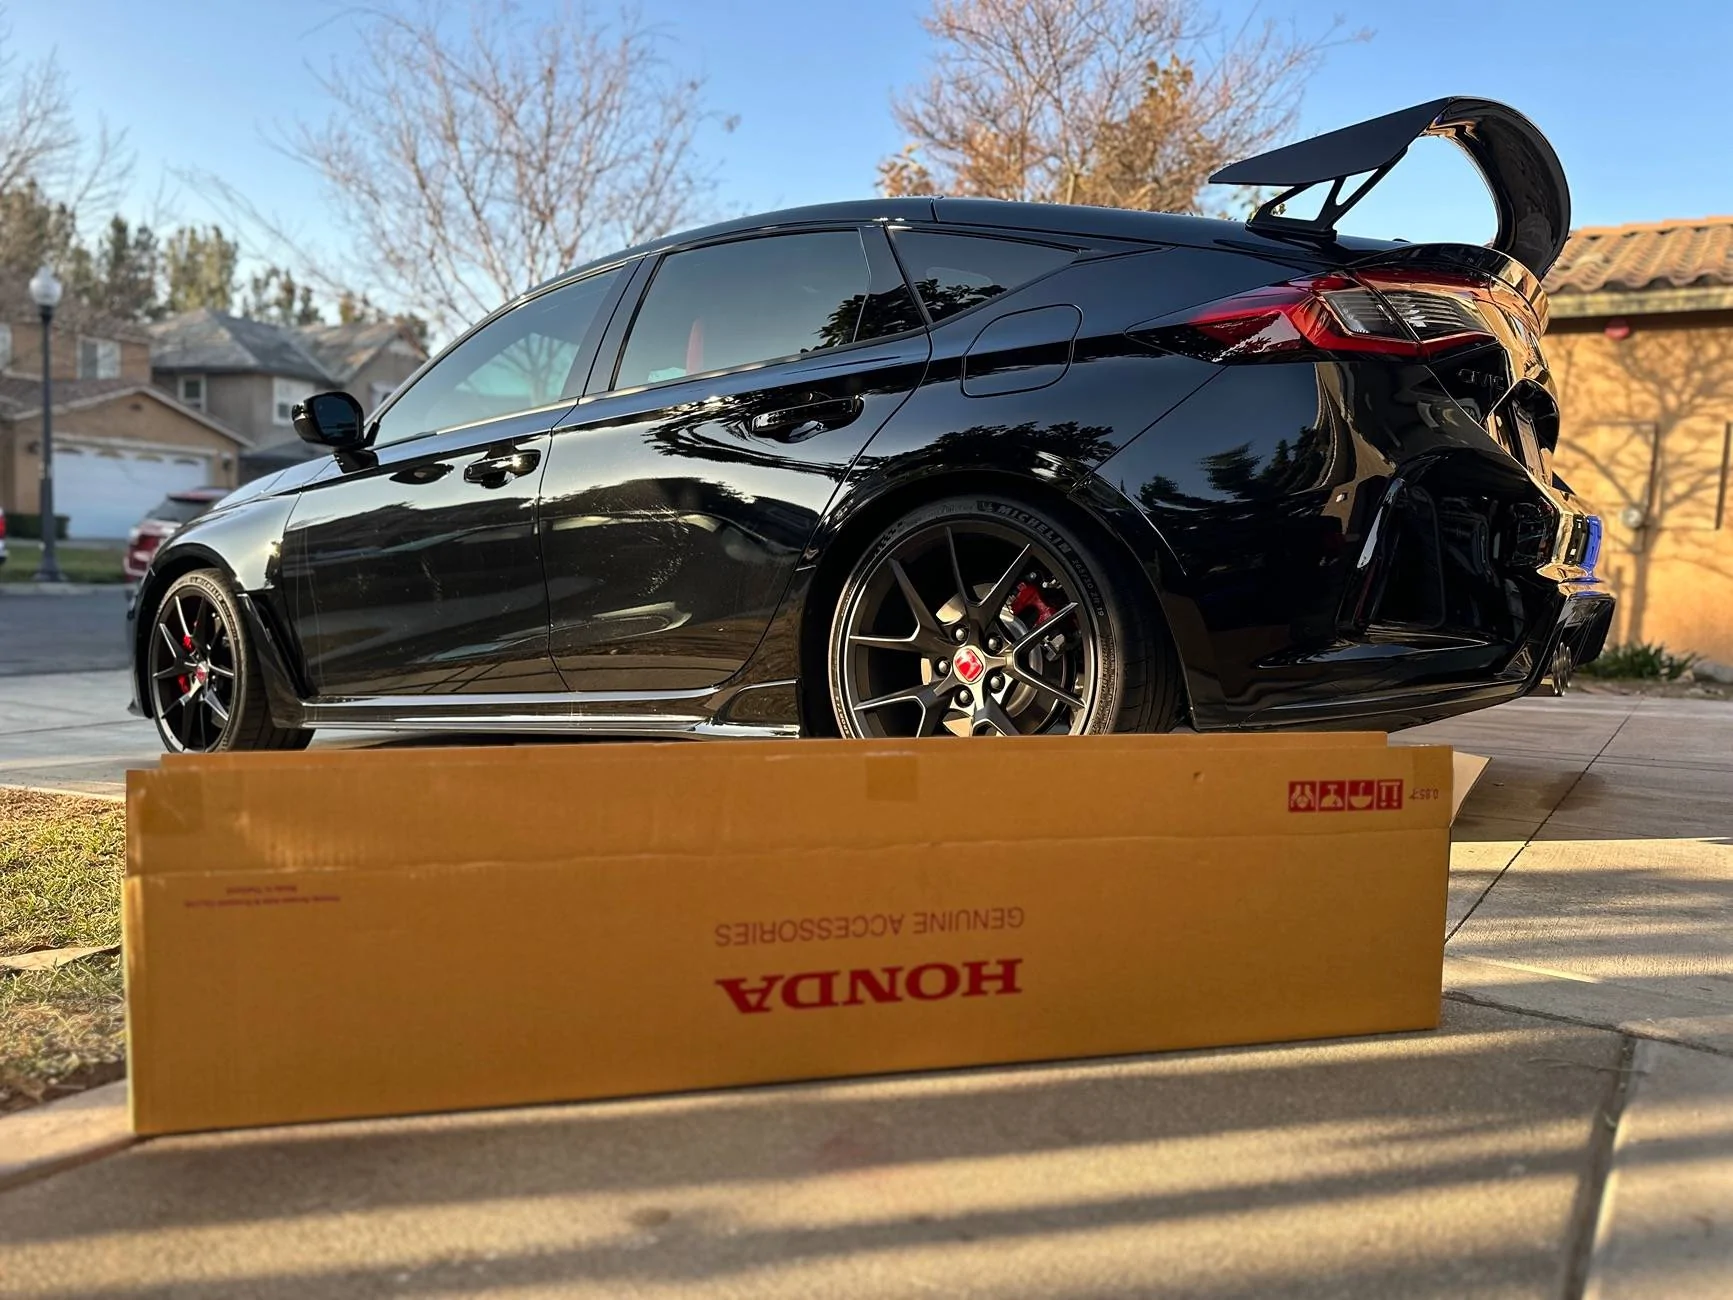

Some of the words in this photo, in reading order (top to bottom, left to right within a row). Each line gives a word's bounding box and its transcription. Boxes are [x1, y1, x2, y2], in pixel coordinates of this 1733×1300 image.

[997, 505, 1072, 555] MICHELIN
[715, 913, 905, 947] ACCESSORIES
[913, 907, 1025, 934] GENUINE
[714, 958, 1024, 1014] HONDA
